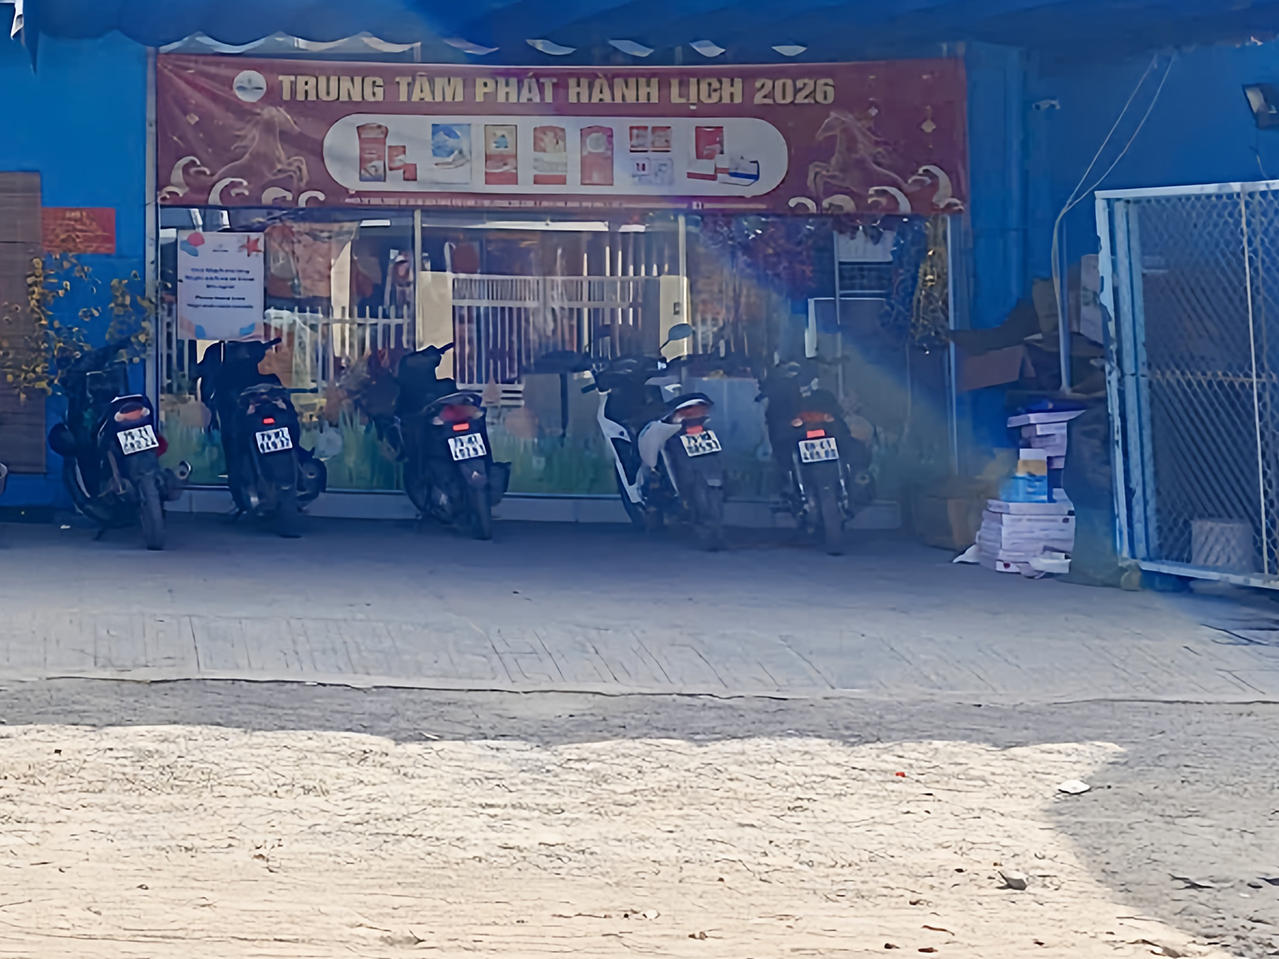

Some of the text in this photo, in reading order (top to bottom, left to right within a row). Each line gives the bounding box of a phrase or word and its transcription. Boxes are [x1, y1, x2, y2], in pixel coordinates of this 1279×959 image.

[278, 72, 835, 110] TRUNG TÂM PHÁT HÀNH LỊCH 2026
